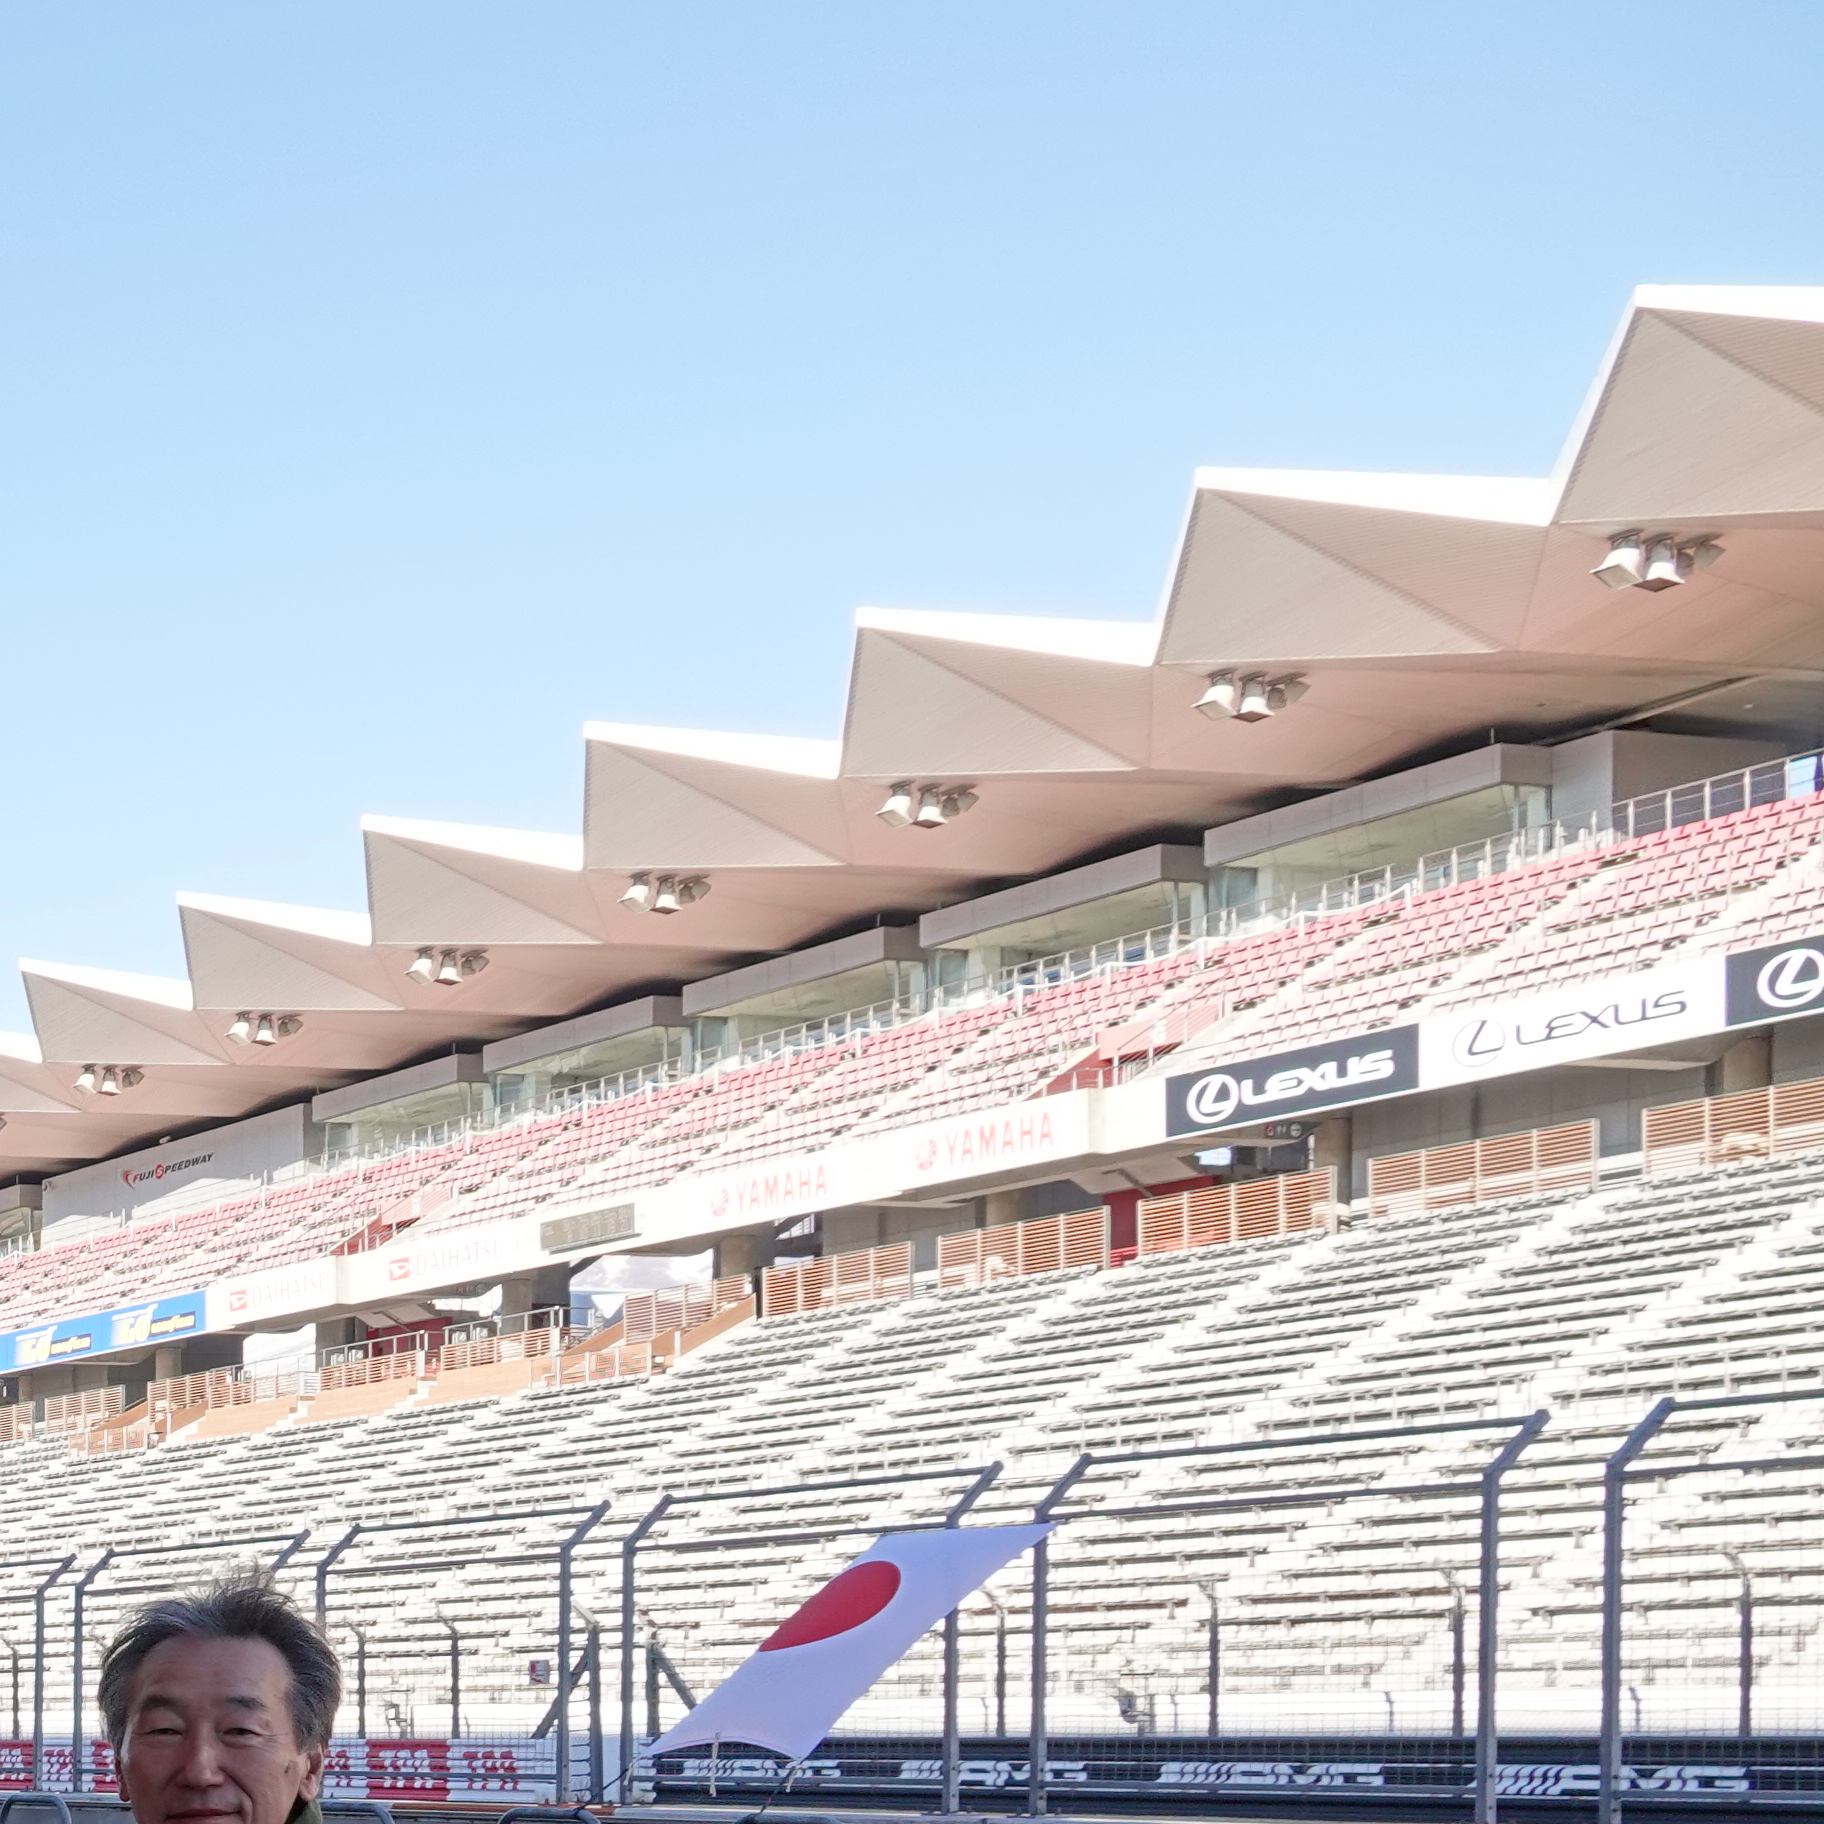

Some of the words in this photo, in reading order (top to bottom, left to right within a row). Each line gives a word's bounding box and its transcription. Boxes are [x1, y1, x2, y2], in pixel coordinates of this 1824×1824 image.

[1515, 988, 1687, 1047] LEXUS
[1240, 1048, 1395, 1106] LEXUS
[944, 1112, 1054, 1165] YAMAHA
[133, 1168, 155, 1184] FUJI
[155, 1152, 214, 1180] SPEEDWAY
[736, 1165, 828, 1212] YAMAHA
